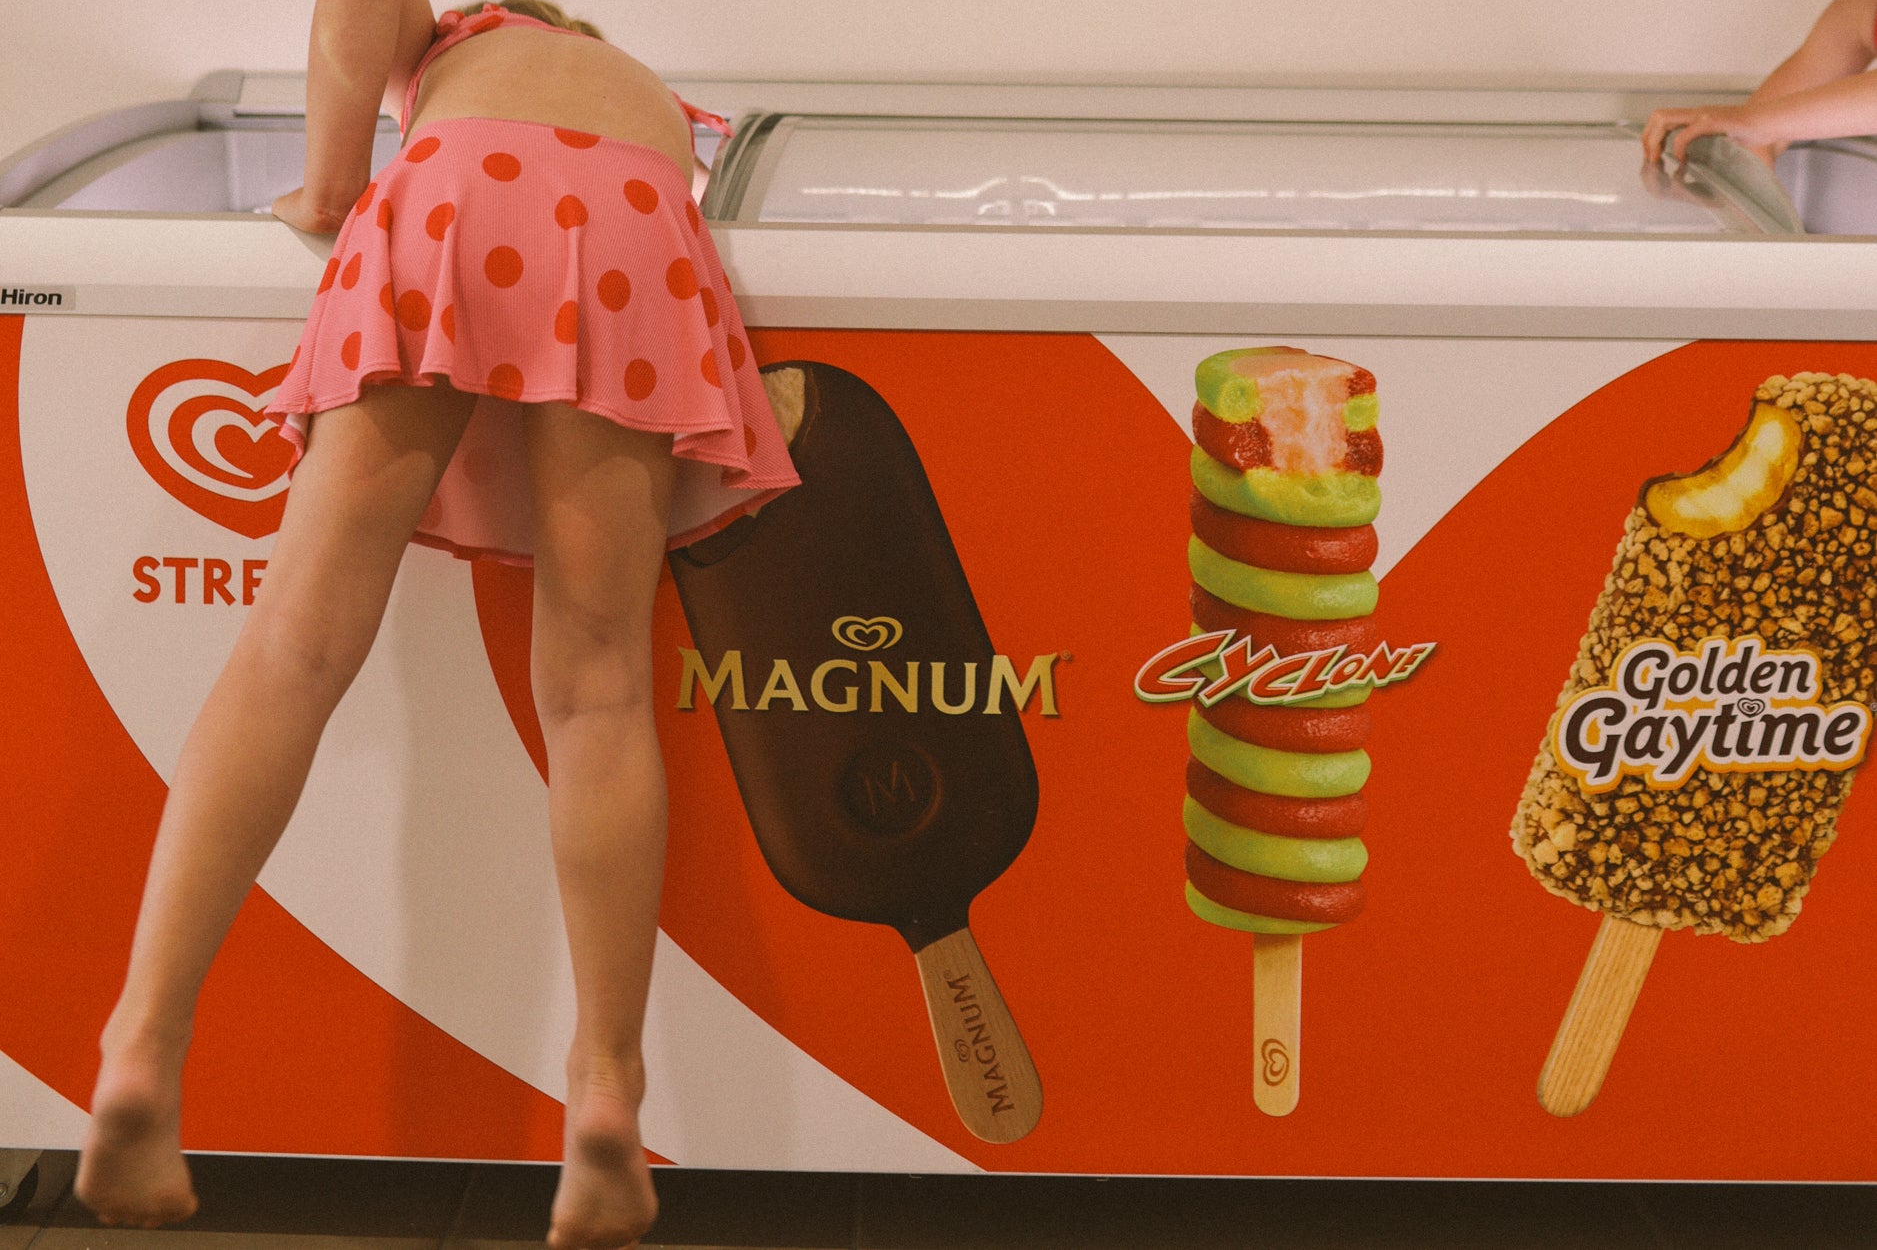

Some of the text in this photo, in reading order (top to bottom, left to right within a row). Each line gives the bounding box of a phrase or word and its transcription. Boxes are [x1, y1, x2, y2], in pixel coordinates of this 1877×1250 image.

[1, 288, 62, 306] Hiron
[132, 554, 269, 607] STRE
[674, 646, 1060, 717] MAGNUM
[1133, 628, 1438, 708] CYCLONE
[1622, 646, 1812, 709] Golden
[1564, 697, 1862, 779] Gaytime
[945, 972, 1016, 1117] MAGNUM
